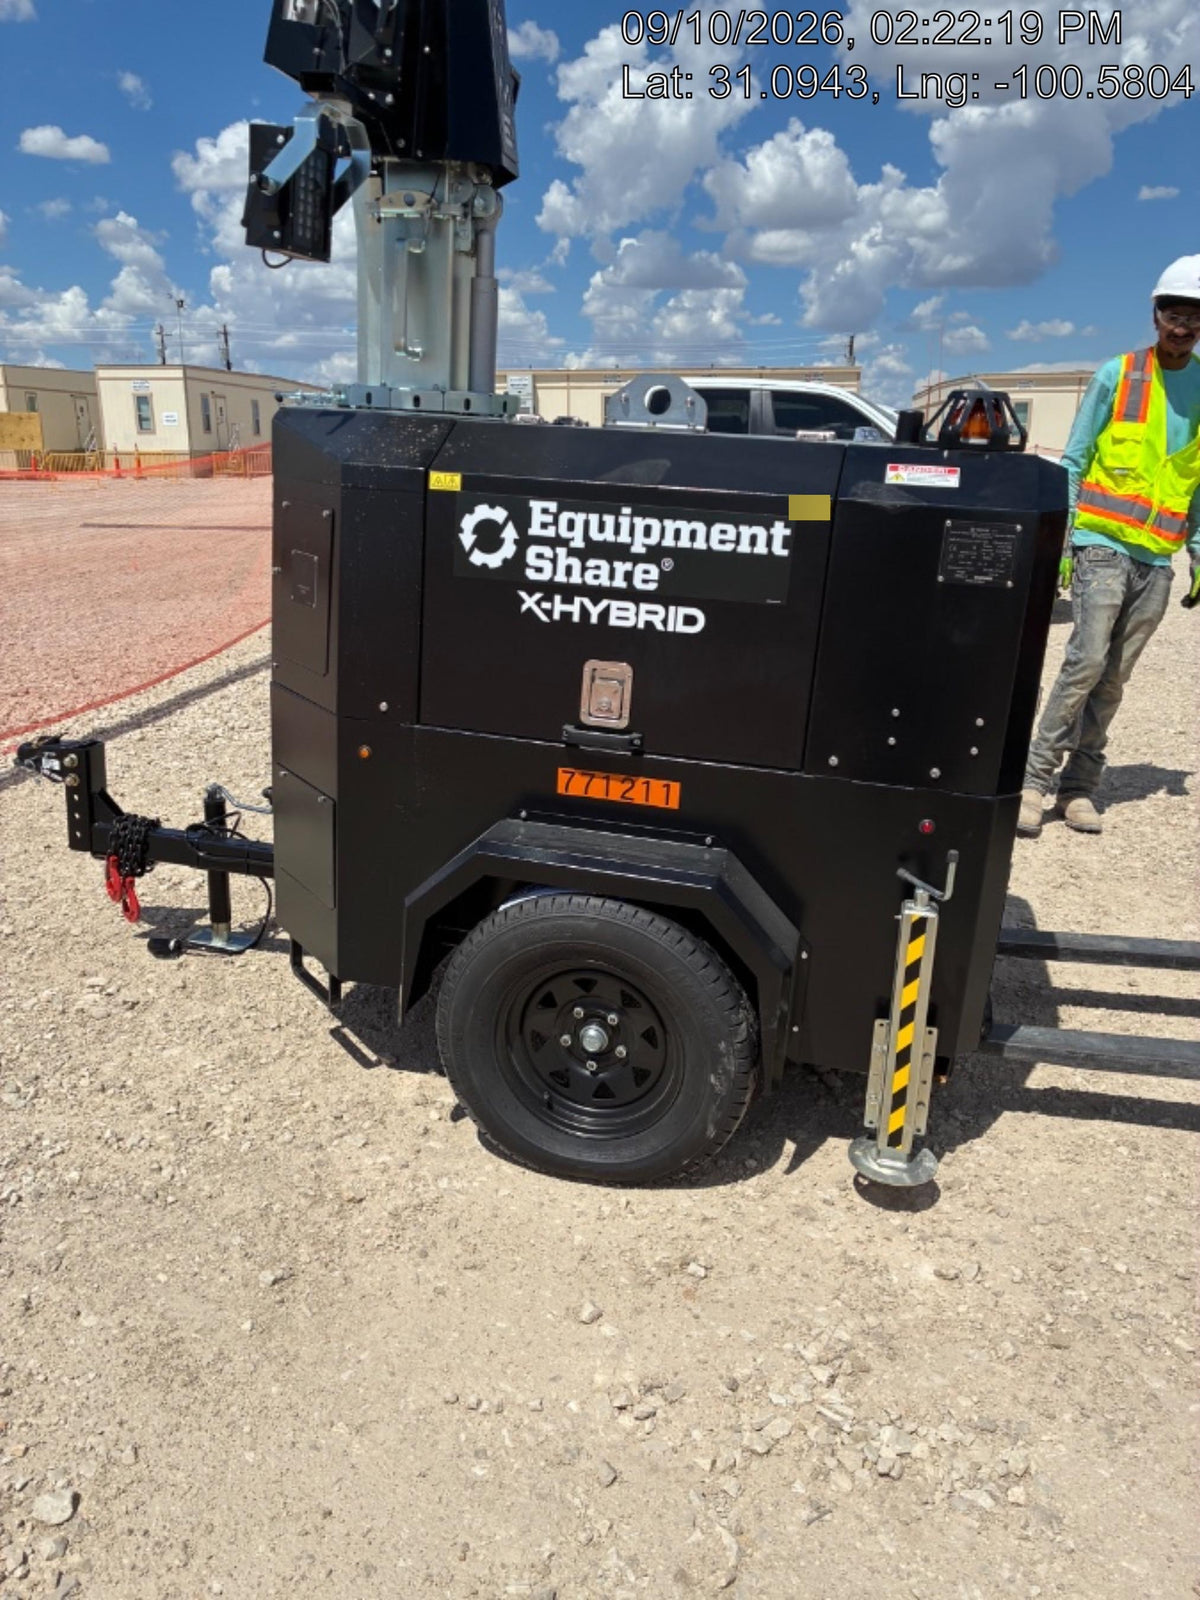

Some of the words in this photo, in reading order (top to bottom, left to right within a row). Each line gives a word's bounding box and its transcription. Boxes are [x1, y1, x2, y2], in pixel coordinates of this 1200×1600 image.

[528, 500, 791, 556] Equipment
[517, 590, 706, 634] X-HYBRID
[560, 769, 672, 806] 771211
